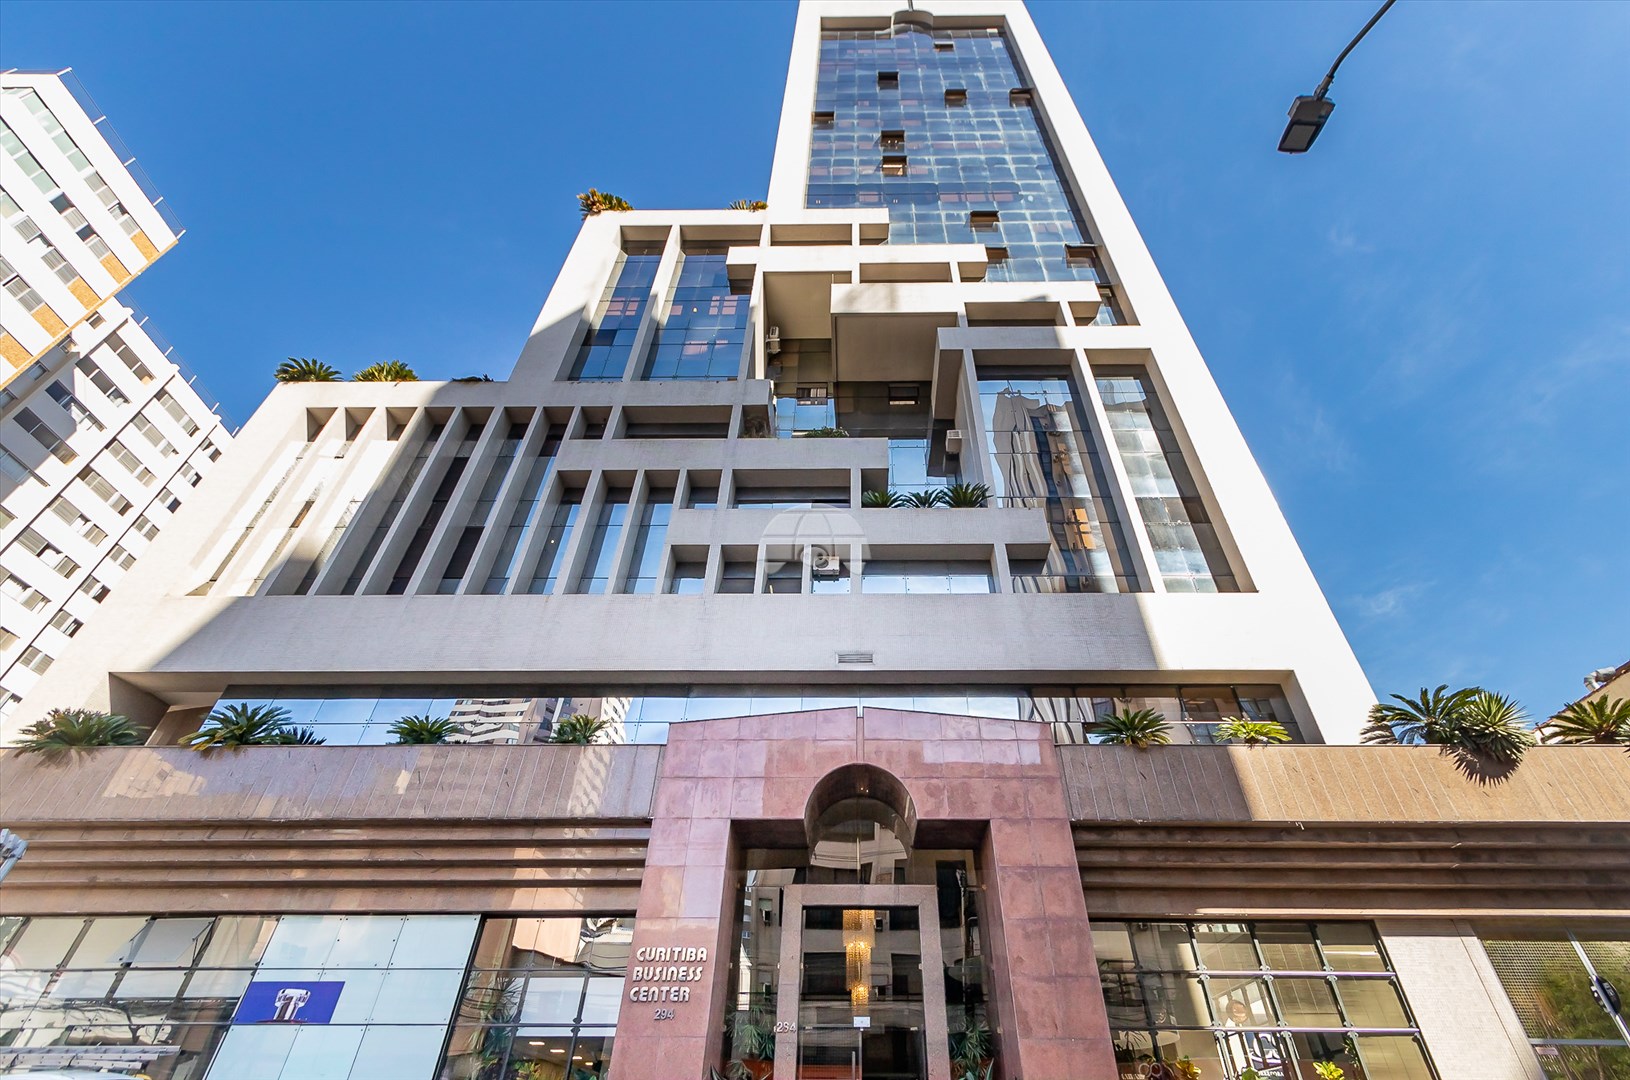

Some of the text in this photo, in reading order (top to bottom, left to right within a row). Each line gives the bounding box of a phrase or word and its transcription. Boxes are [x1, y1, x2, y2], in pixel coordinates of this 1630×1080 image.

[636, 946, 708, 963] CURITIBA
[632, 966, 704, 983] BUSINESS
[629, 986, 691, 1003] CENTER
[653, 1008, 676, 1021] 294
